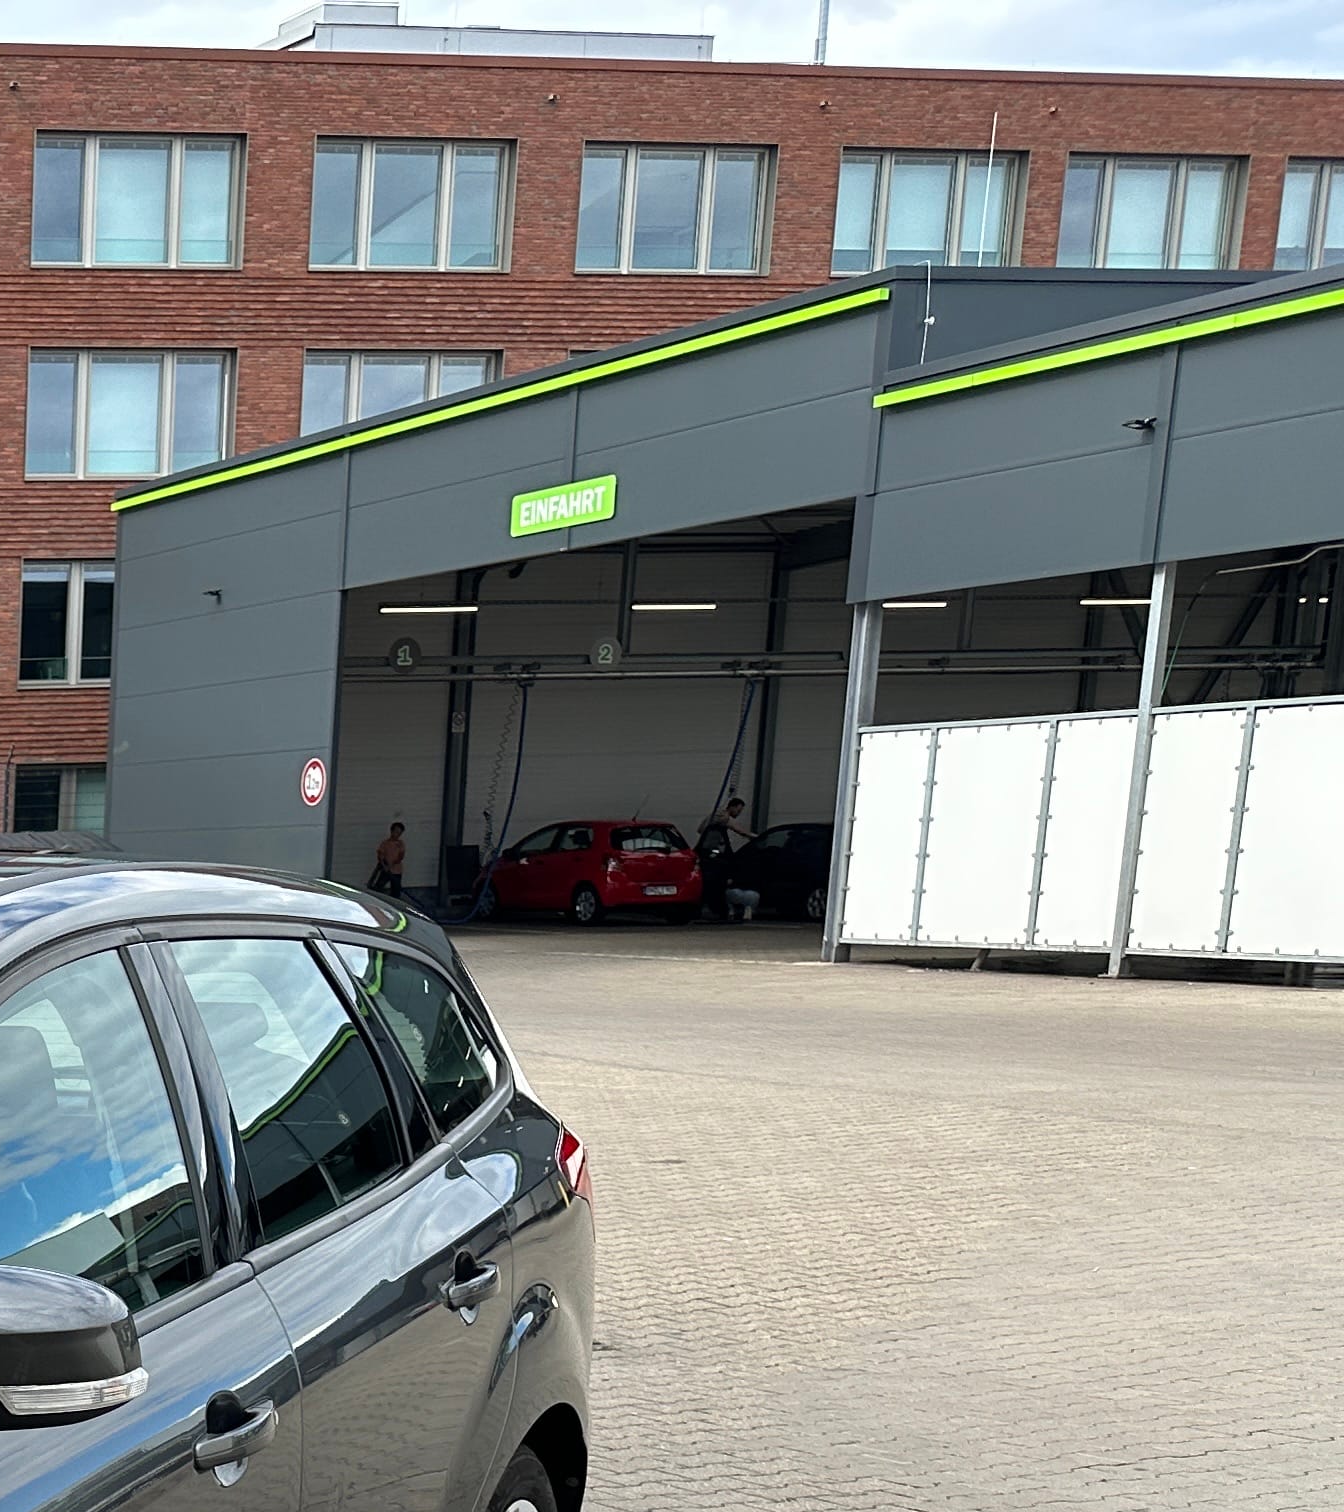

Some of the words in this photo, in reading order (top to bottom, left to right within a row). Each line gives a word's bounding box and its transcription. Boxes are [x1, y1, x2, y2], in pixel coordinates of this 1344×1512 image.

[519, 485, 607, 528] EINFAHRT
[397, 645, 413, 665] 1
[598, 644, 613, 664] 2
